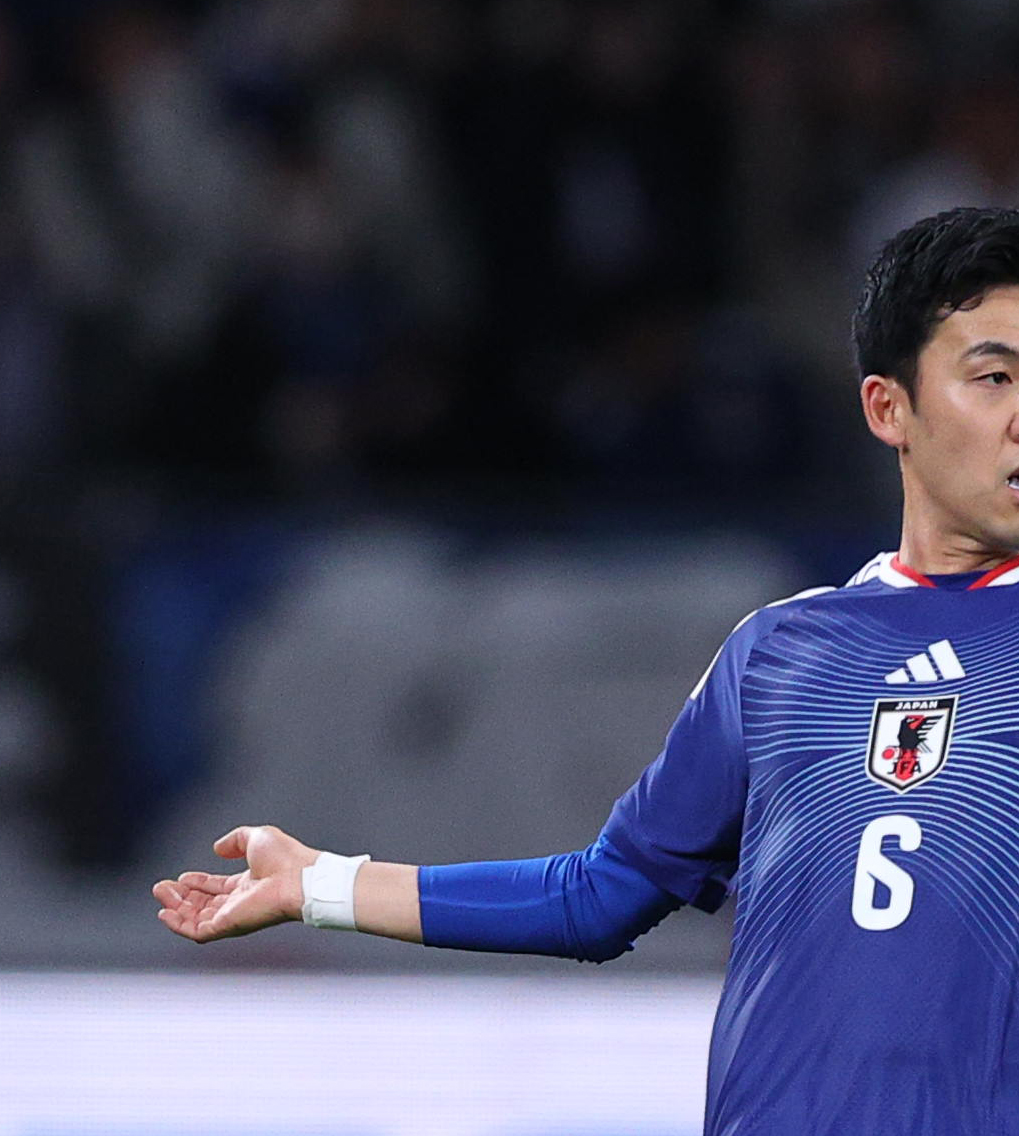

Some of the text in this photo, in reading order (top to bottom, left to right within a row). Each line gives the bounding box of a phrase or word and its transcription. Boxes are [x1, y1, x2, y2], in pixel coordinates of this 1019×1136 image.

[895, 701, 938, 711] JAPAN
[887, 760, 922, 775] JFA
[852, 814, 922, 931] 6
